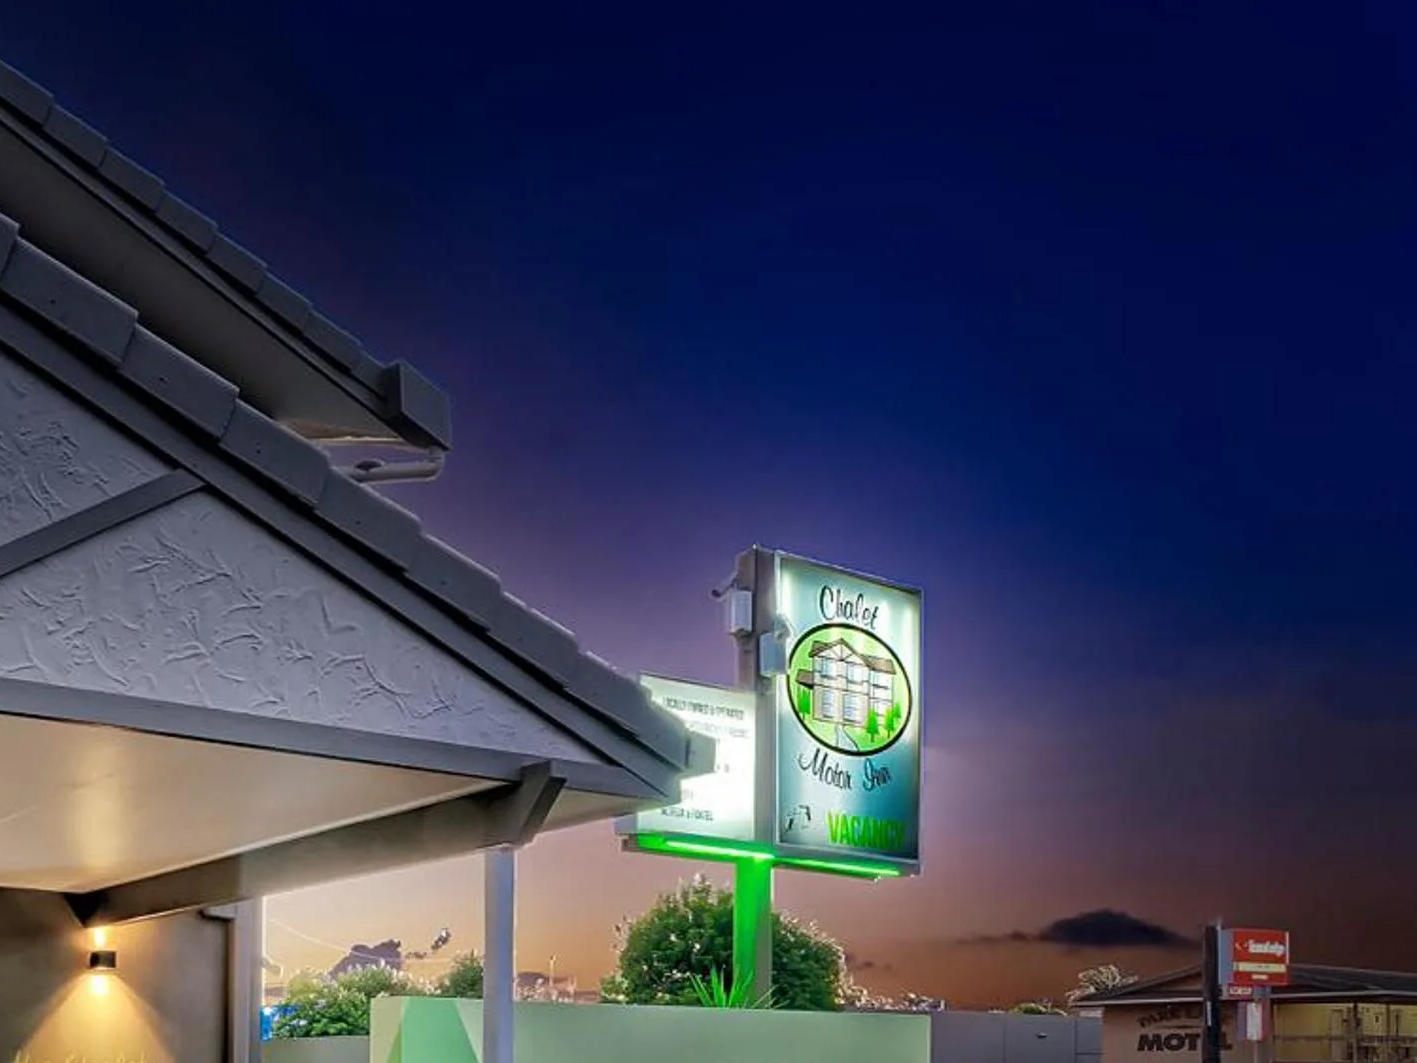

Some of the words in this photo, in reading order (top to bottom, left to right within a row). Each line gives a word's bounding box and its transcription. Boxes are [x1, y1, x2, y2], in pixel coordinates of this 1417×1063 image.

[820, 585, 879, 630] Chalet
[798, 748, 852, 790] Motor
[863, 758, 892, 791] Inn
[1137, 1033, 1233, 1051] MOTL
